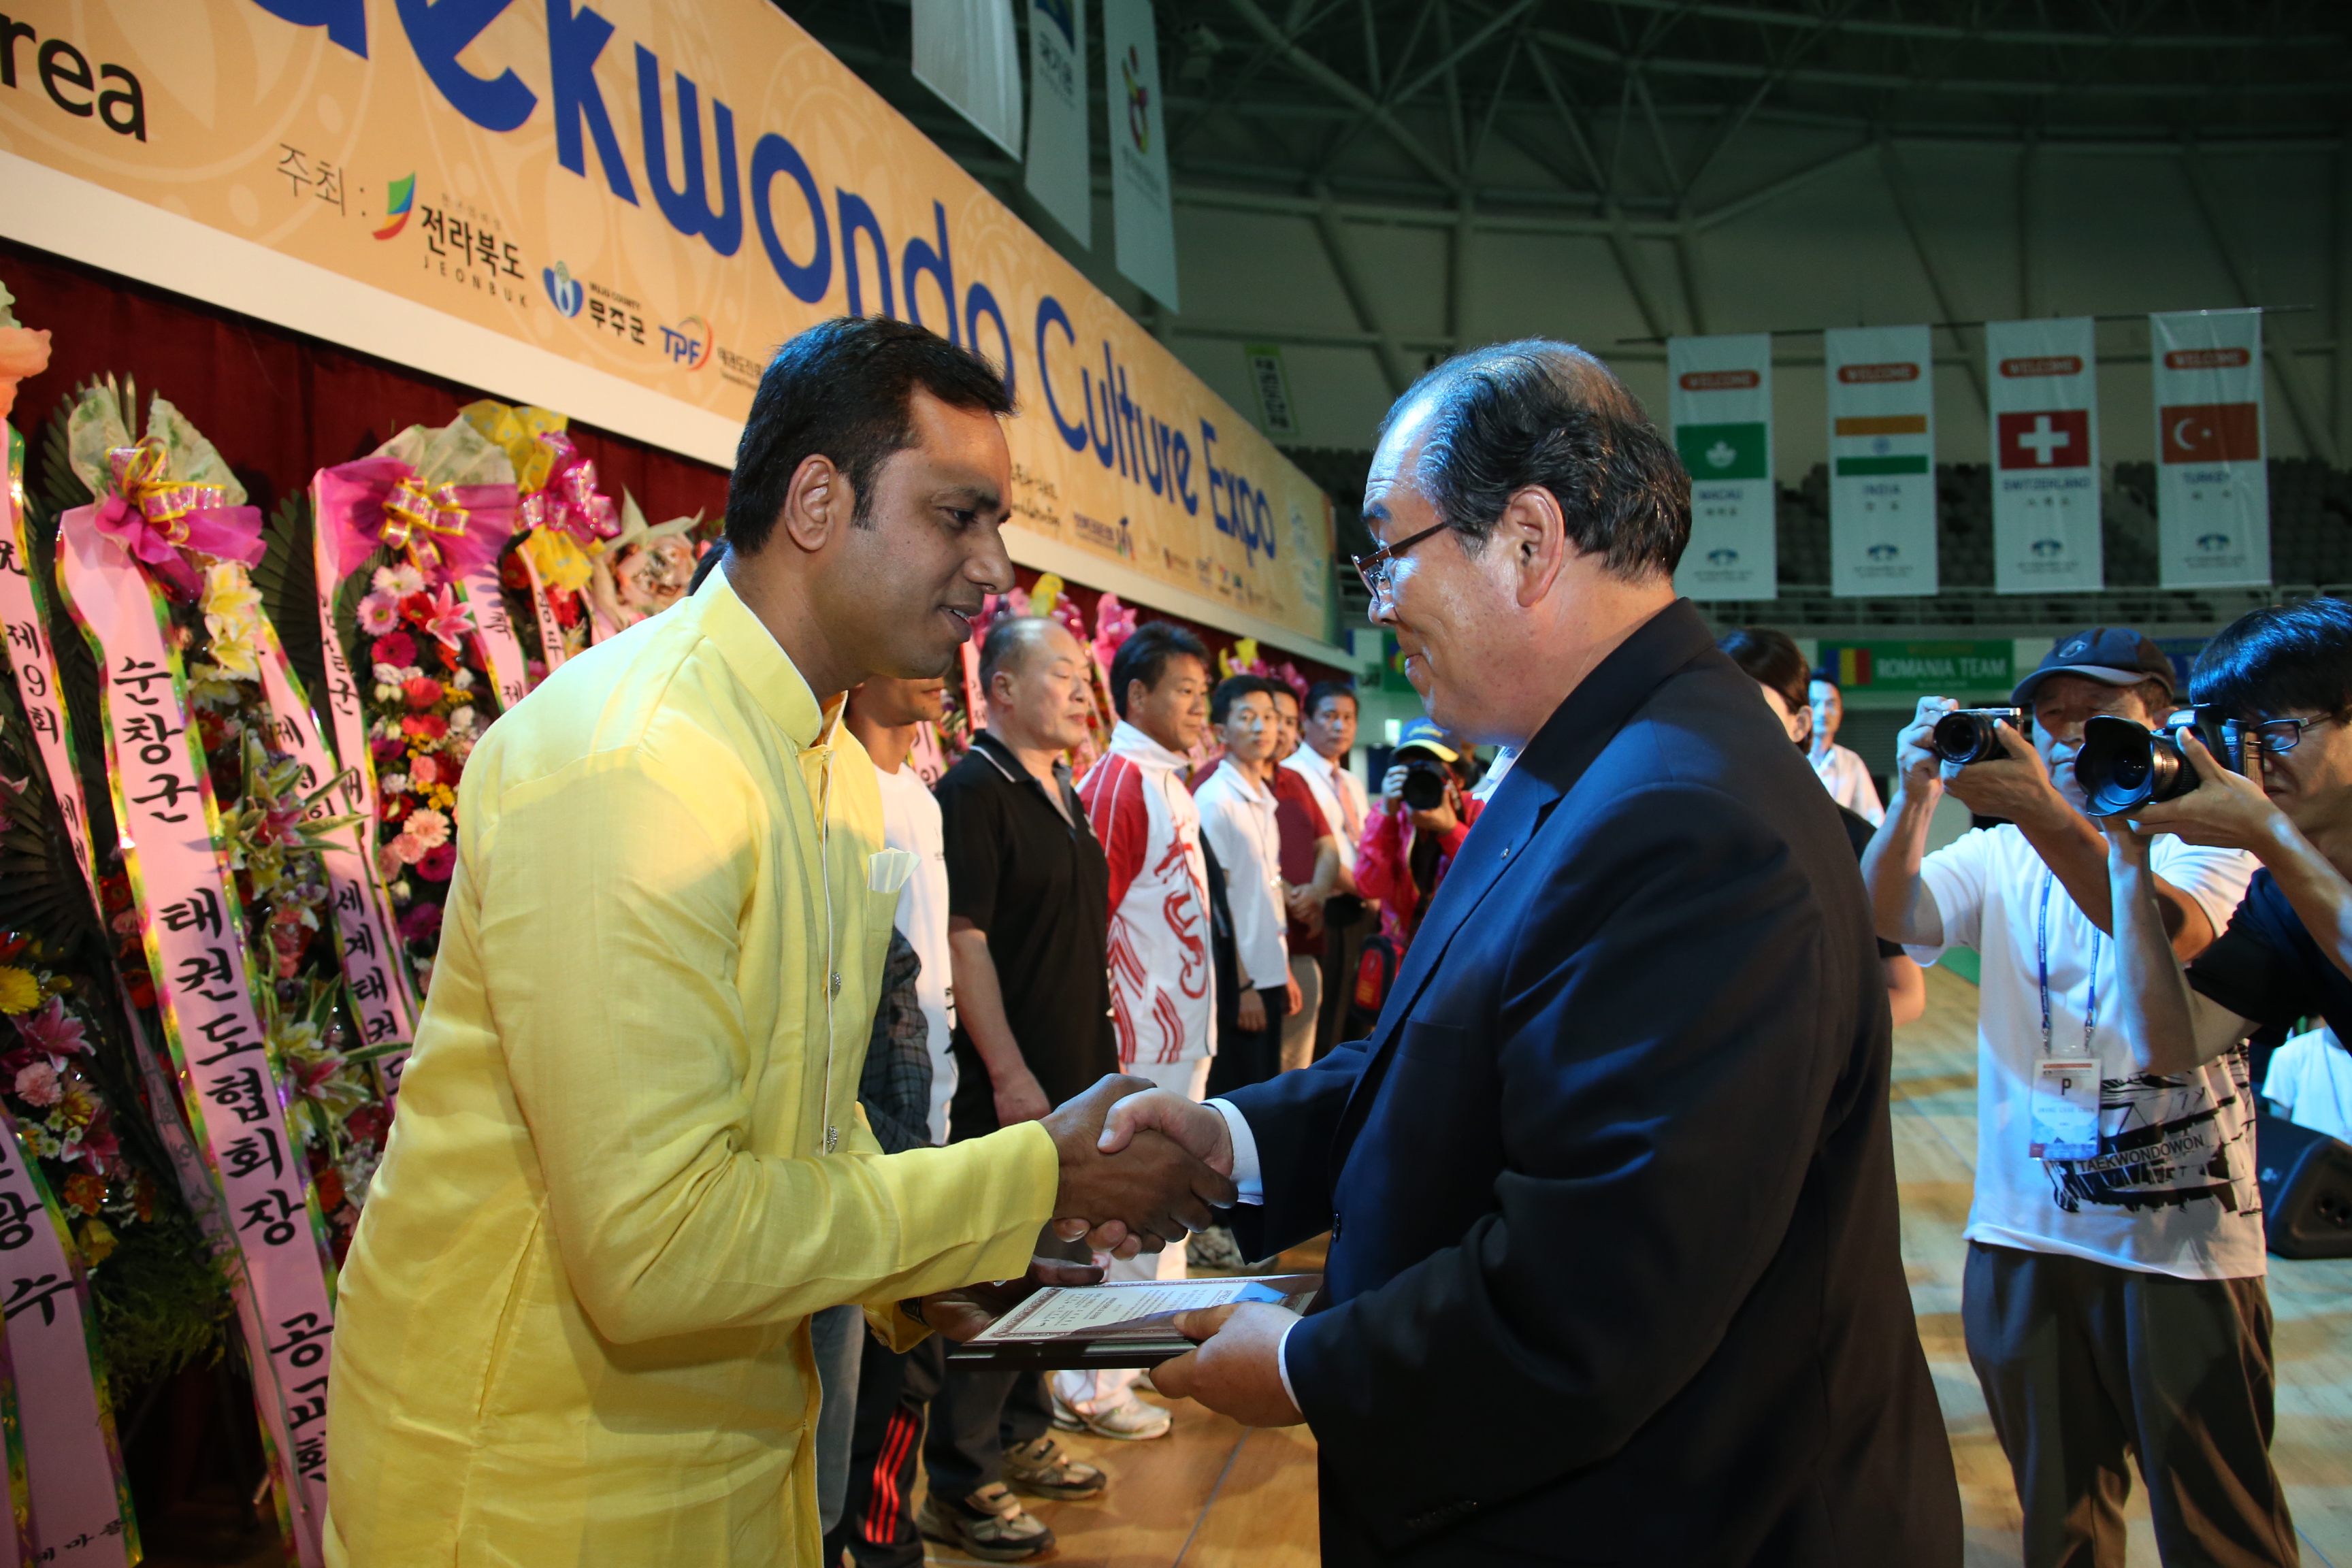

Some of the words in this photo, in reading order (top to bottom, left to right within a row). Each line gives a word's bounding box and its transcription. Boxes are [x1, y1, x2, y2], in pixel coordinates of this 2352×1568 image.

[0, 12, 147, 143] rea
[277, 142, 347, 216] 주최
[420, 204, 525, 280] 전라북도
[252, 0, 1015, 410] ekwondo
[1035, 295, 1198, 517] Culture
[1200, 417, 1276, 568] Expo
[424, 255, 528, 308] JEONBUK
[589, 298, 645, 346] 무주군
[659, 325, 701, 365] TPF
[2174, 352, 2240, 368] WELCOME
[1689, 372, 1751, 387] WELCOME
[1847, 365, 1910, 380] WELCOME
[2010, 359, 2074, 374] WELCOME
[1863, 484, 1901, 496] INDIA
[2003, 478, 2090, 491] SWITZERLAND
[5, 621, 59, 745] 제9회
[1877, 658, 1956, 678] ROMANIA
[1960, 657, 2006, 677] TEAM
[2169, 717, 2193, 725] Canon
[112, 656, 199, 823] 순창군
[159, 887, 306, 1247] 태권도협회장
[2061, 1077, 2072, 1096] P
[2077, 1134, 2204, 1171] TAEKWONDOWON
